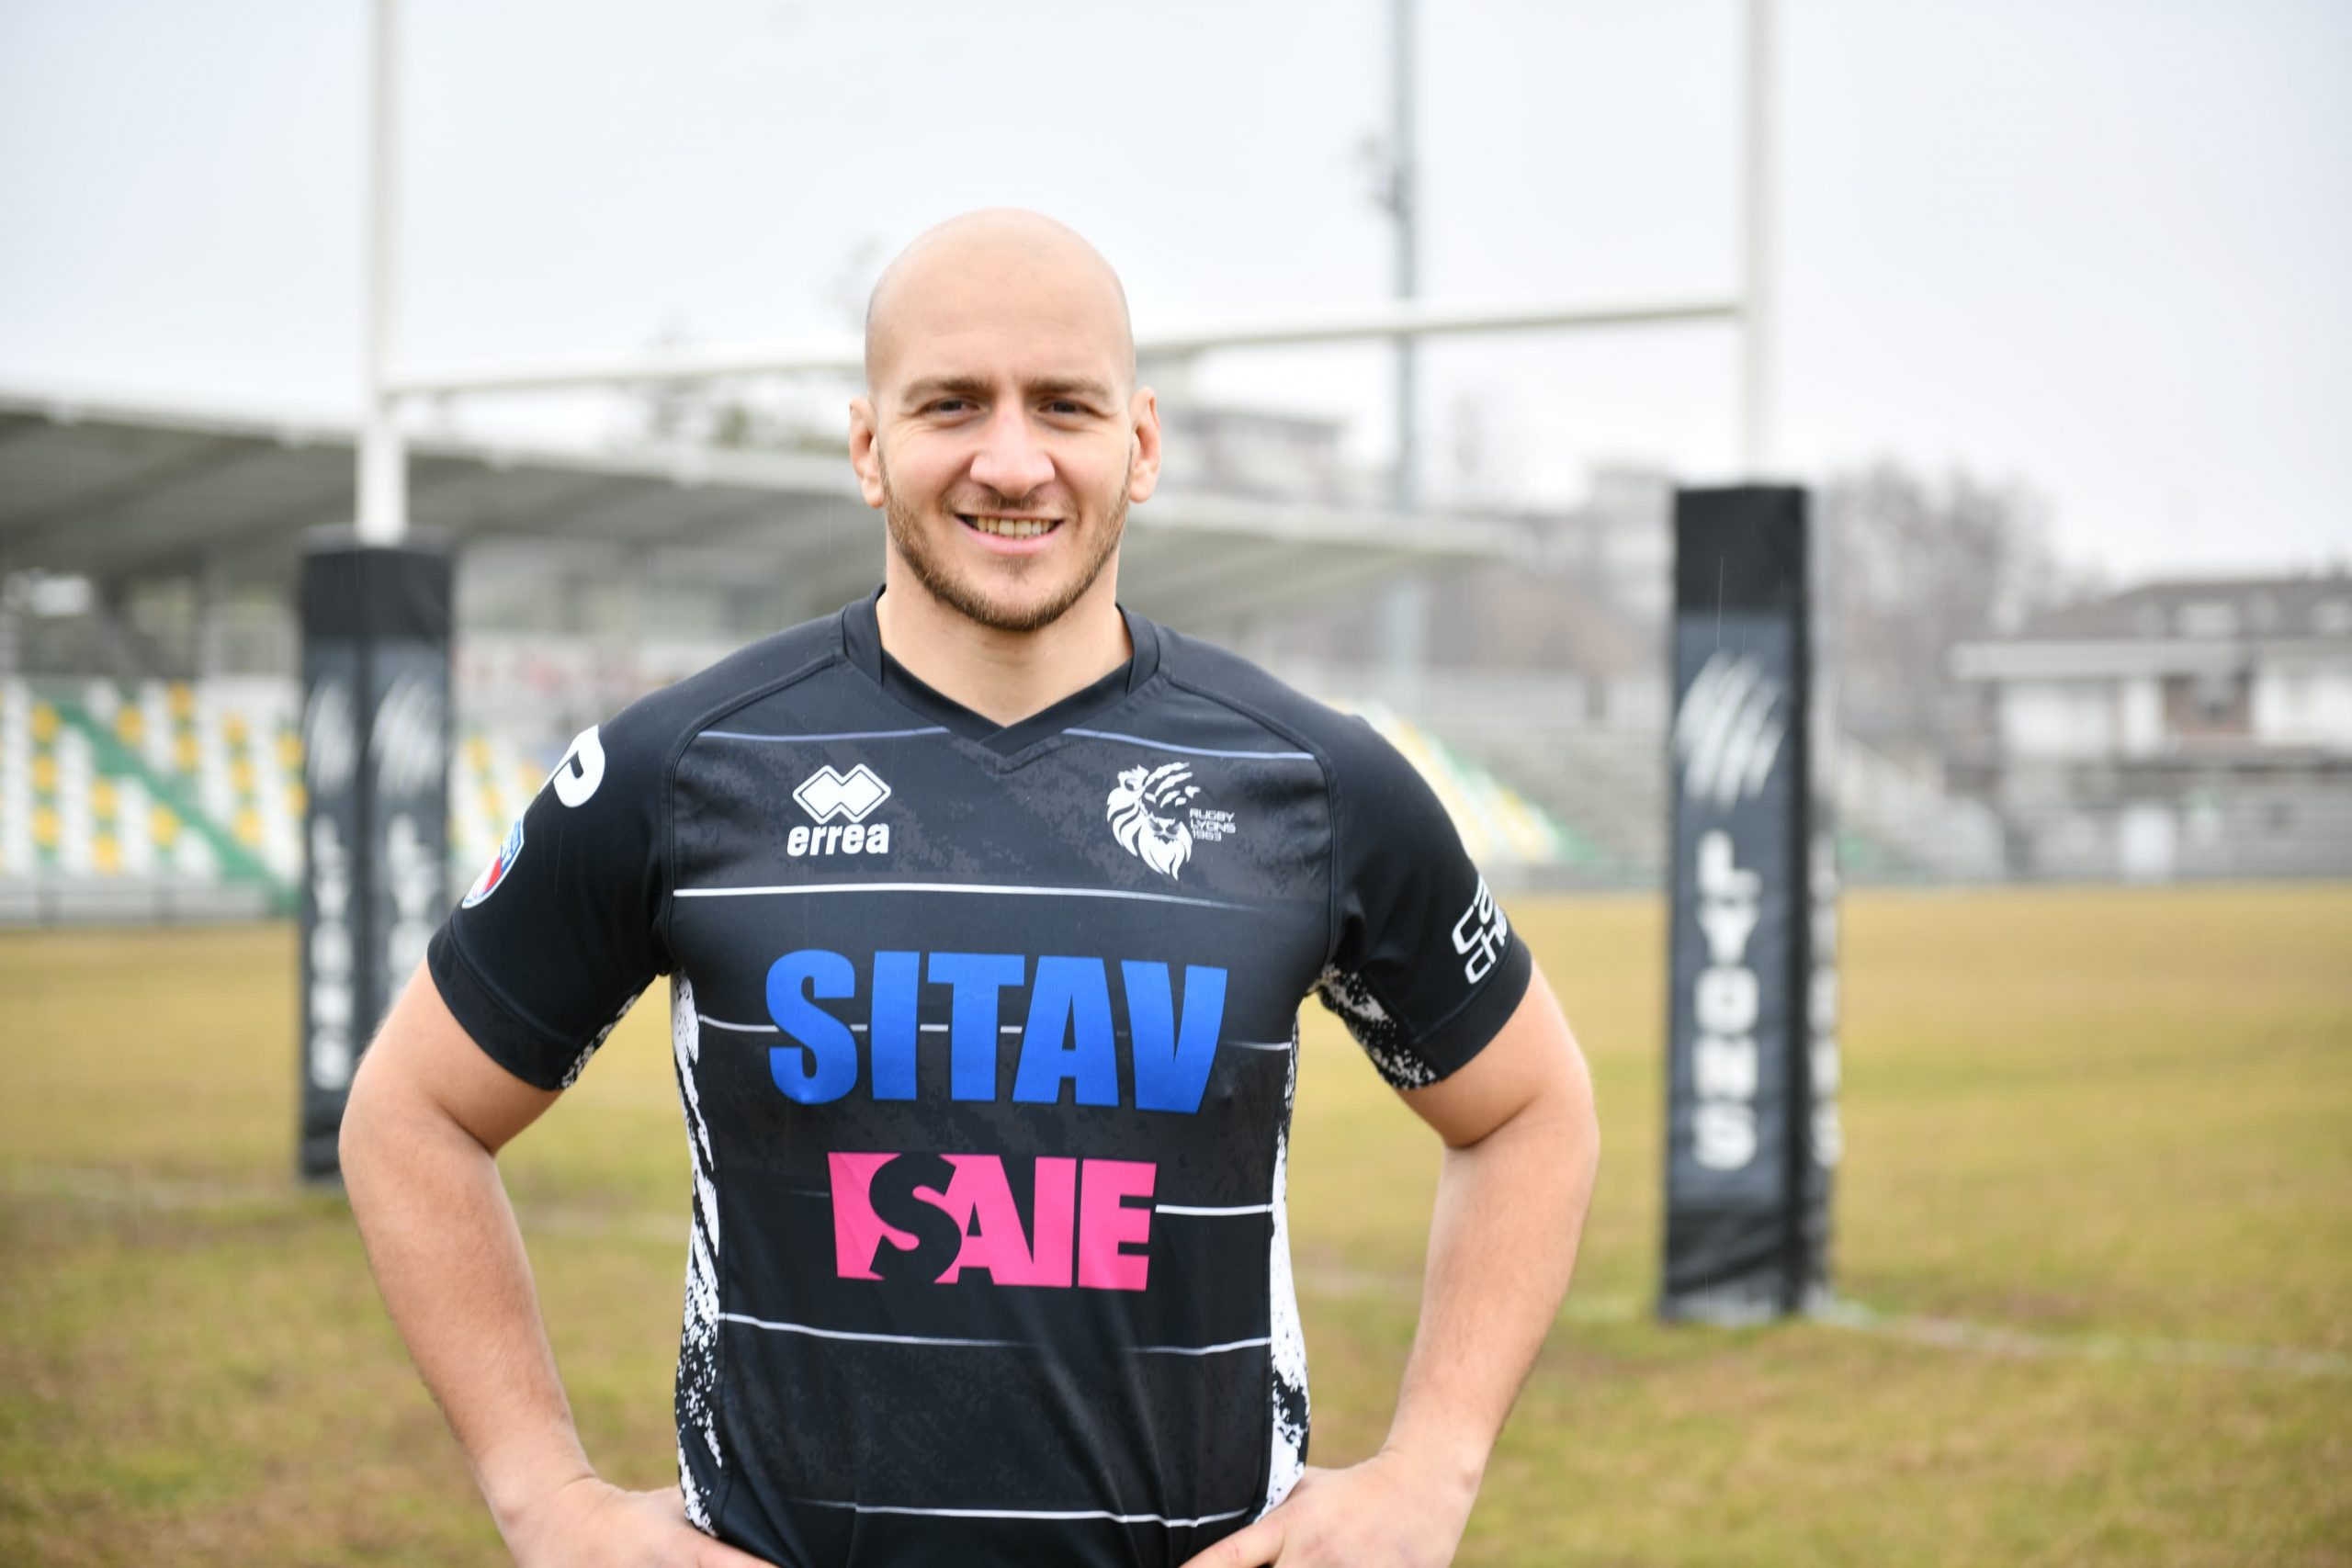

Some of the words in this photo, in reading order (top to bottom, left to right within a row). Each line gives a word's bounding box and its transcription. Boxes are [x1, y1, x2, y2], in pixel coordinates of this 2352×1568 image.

[1190, 807, 1235, 822] RUGBY
[1190, 818, 1237, 833] LYONS
[786, 822, 890, 857] errea
[764, 949, 1228, 1114] SITAV
[827, 1151, 1158, 1292] SAIE
